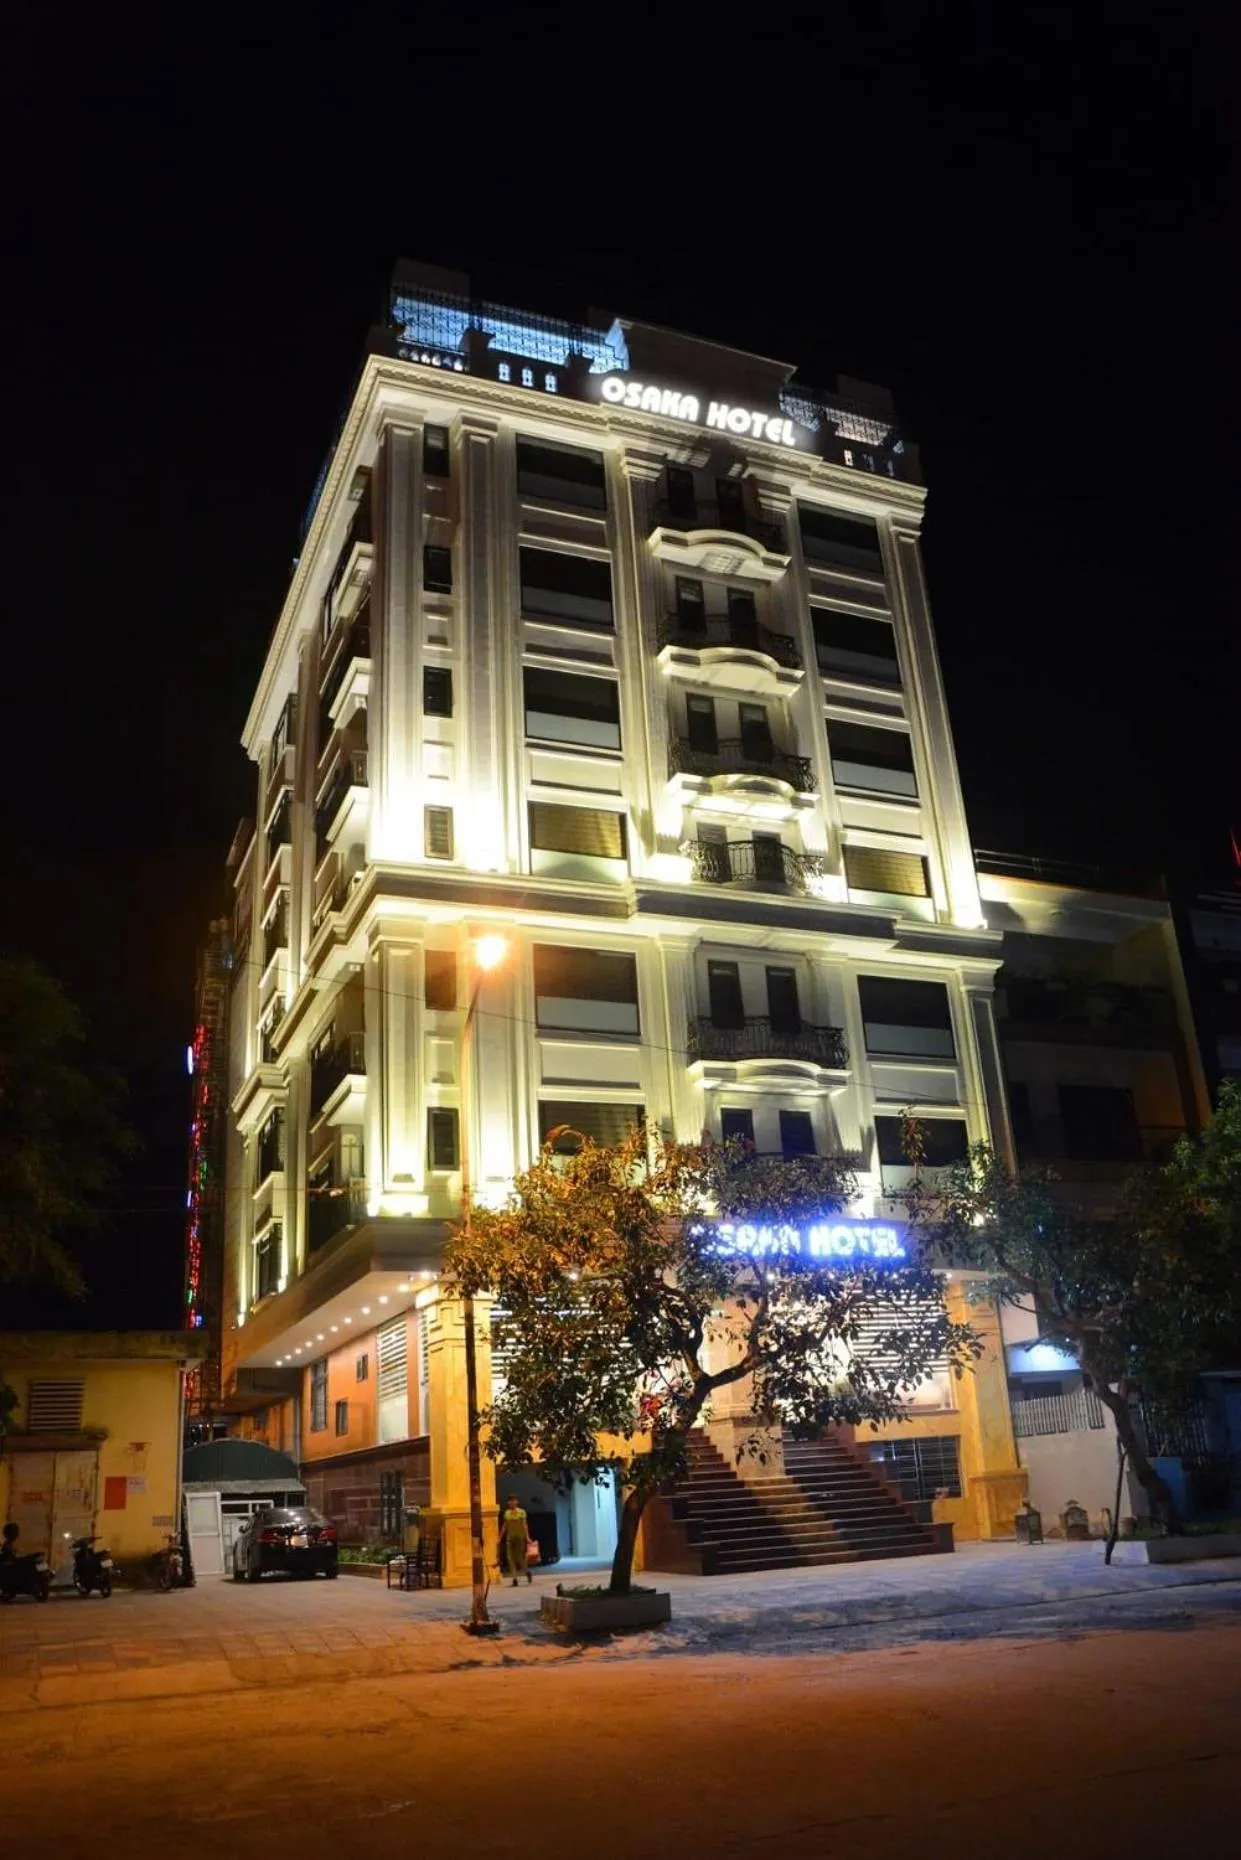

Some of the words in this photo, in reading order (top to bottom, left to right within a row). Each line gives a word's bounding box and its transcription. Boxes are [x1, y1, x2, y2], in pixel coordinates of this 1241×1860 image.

[601, 377, 699, 422] OSAKA
[706, 401, 796, 446] HOTEL
[810, 1225, 906, 1257] HOTEL
